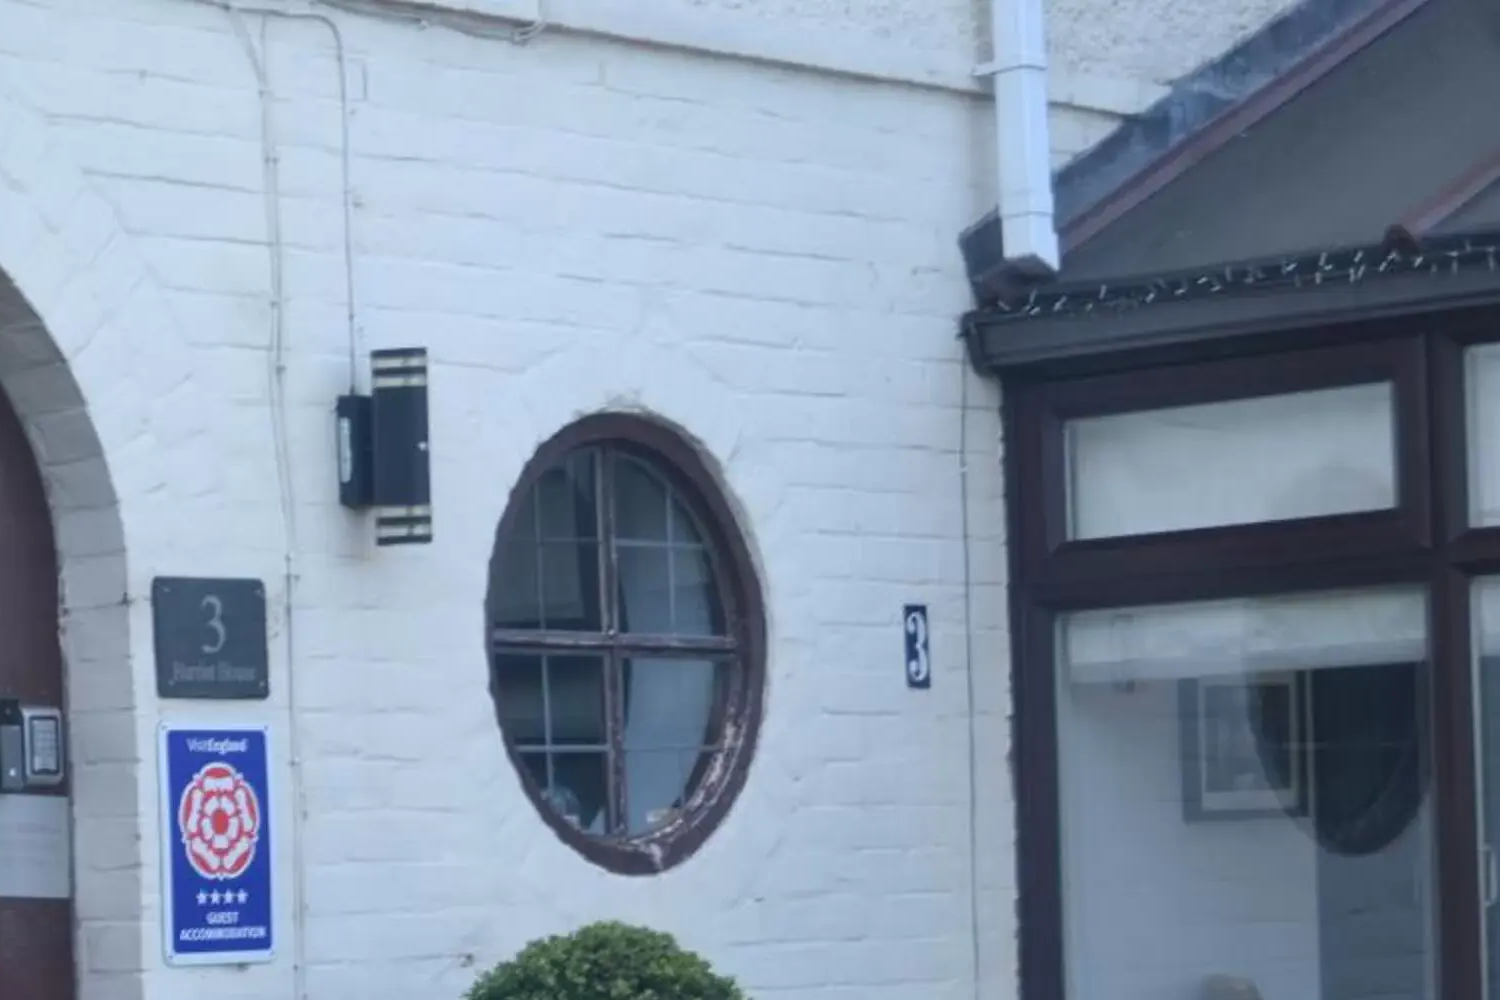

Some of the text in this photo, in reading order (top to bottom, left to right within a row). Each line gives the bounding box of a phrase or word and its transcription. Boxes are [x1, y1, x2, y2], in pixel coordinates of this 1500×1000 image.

[201, 594, 226, 653] 3
[907, 611, 928, 681] 3
[206, 911, 239, 925] GUEST
